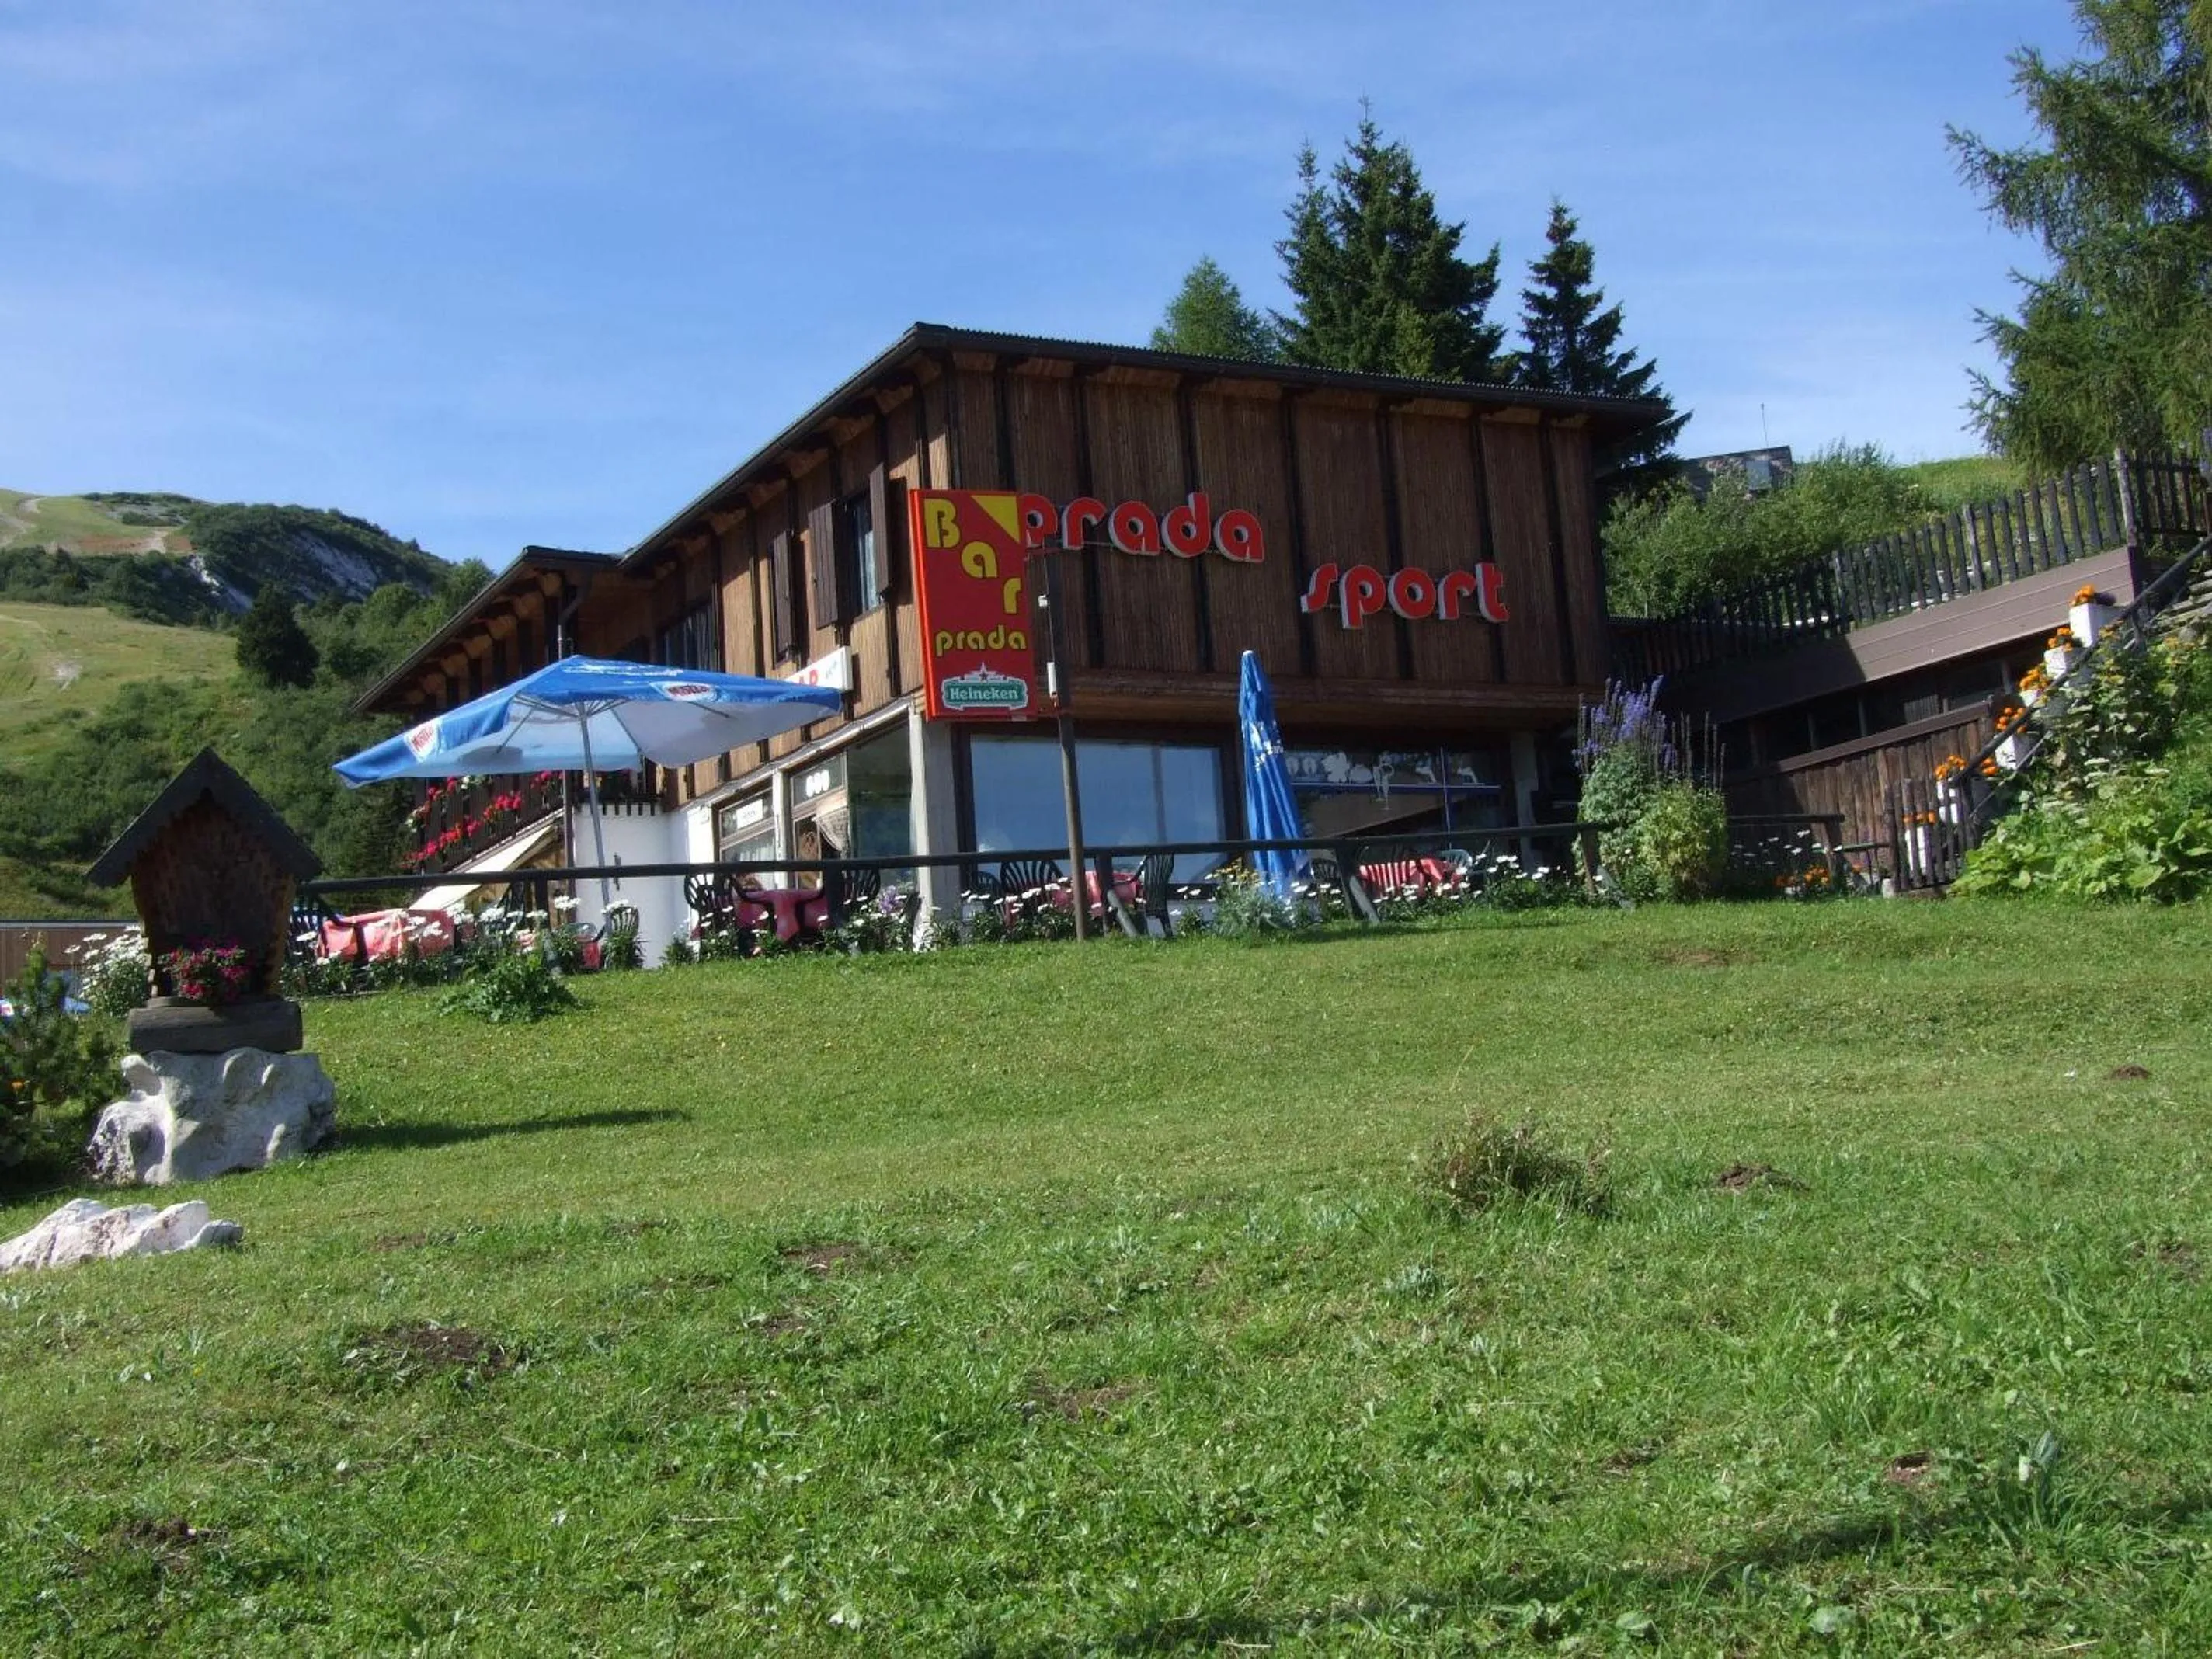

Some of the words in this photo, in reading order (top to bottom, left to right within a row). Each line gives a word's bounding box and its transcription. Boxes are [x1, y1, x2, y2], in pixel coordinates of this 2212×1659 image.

[924, 498, 1021, 614] Bar
[1020, 492, 1265, 563] prada
[1300, 562, 1510, 629] sport
[935, 624, 1027, 657] prada
[949, 687, 1019, 701] Heineken
